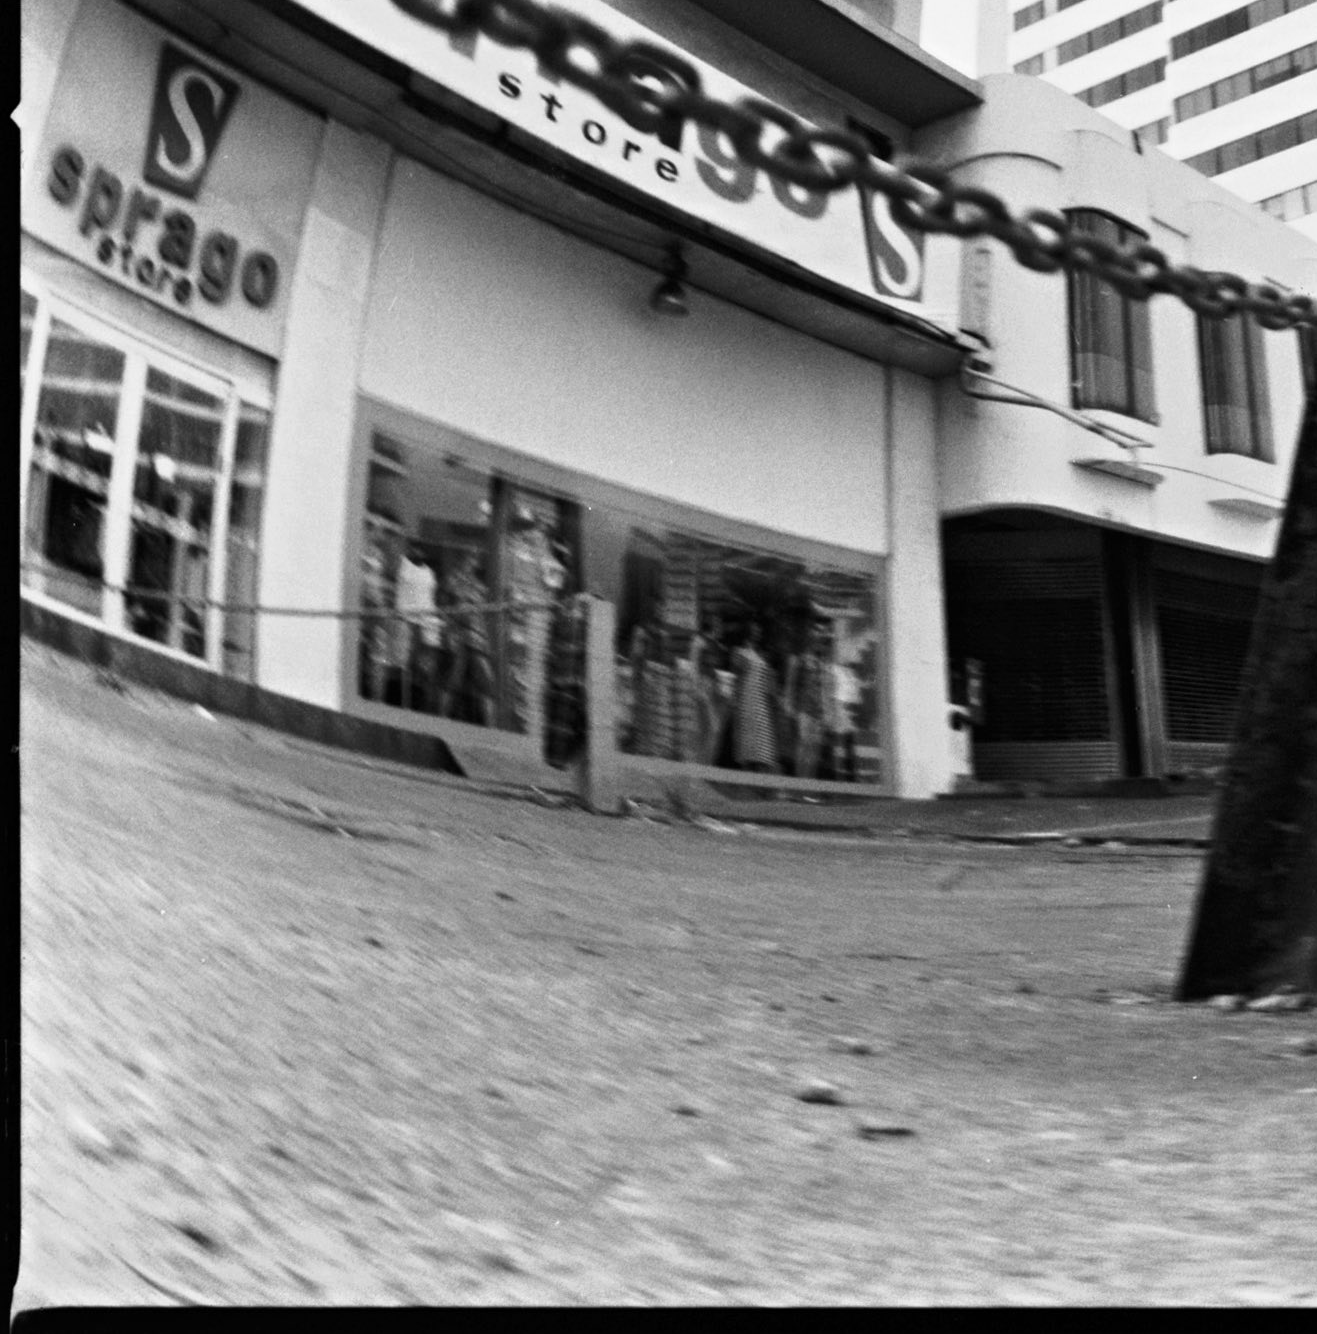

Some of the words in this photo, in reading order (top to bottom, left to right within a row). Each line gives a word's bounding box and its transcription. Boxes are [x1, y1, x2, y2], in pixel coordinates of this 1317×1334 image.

[155, 68, 226, 183] S
[497, 70, 681, 184] store
[48, 143, 279, 309] sprago
[96, 235, 193, 306] store
